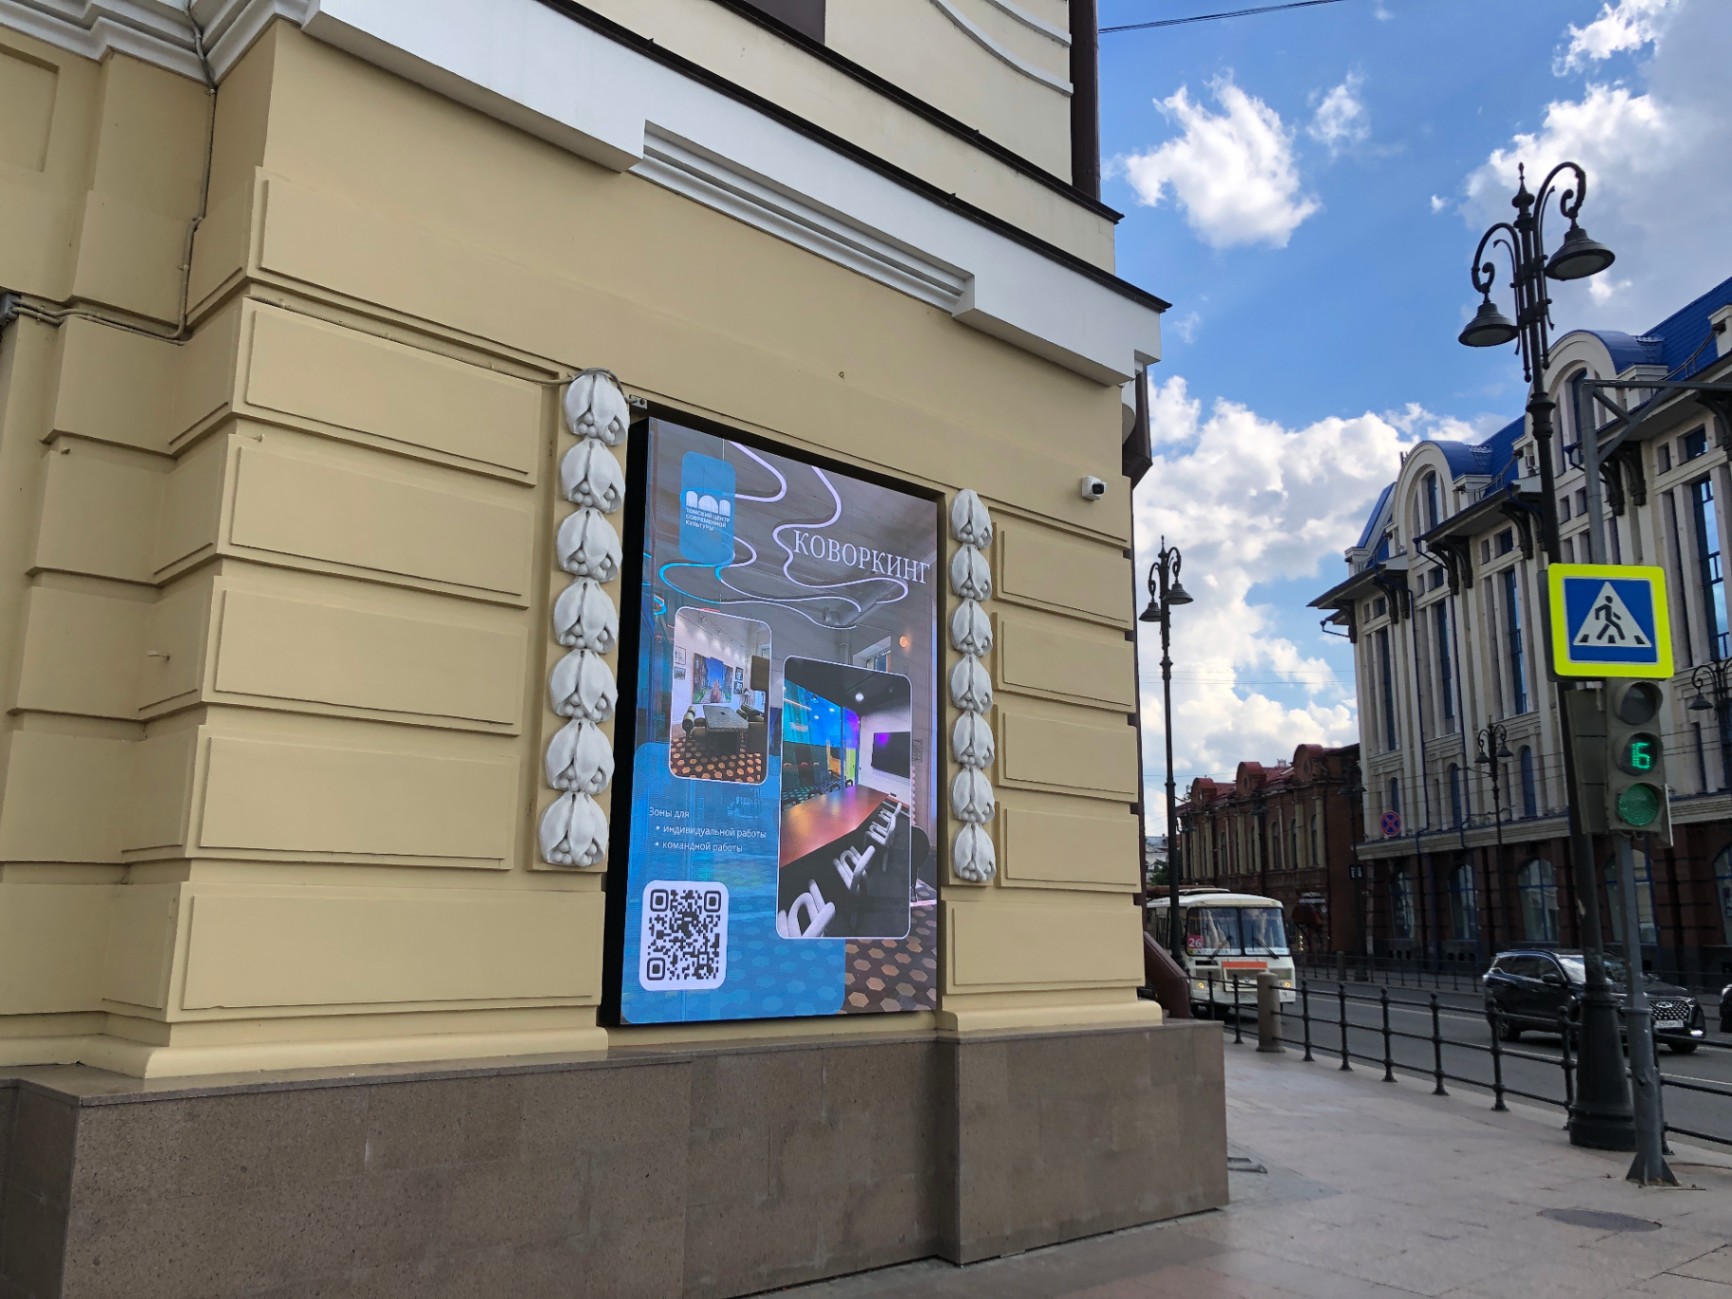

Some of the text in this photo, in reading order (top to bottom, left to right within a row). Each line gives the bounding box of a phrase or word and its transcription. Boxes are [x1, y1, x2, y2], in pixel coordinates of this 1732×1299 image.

[685, 507, 712, 518] ТОМСКИЙ
[685, 513, 728, 529] СОВРЕМЕННОЙ
[685, 519, 714, 531] КУЛЬТУРЫ
[793, 529, 931, 585] КОВОРКИНГ
[649, 806, 690, 819] Зоны для
[663, 825, 767, 840] индивидуальной работы
[662, 841, 743, 853] командной работы
[1188, 938, 1203, 948] 26
